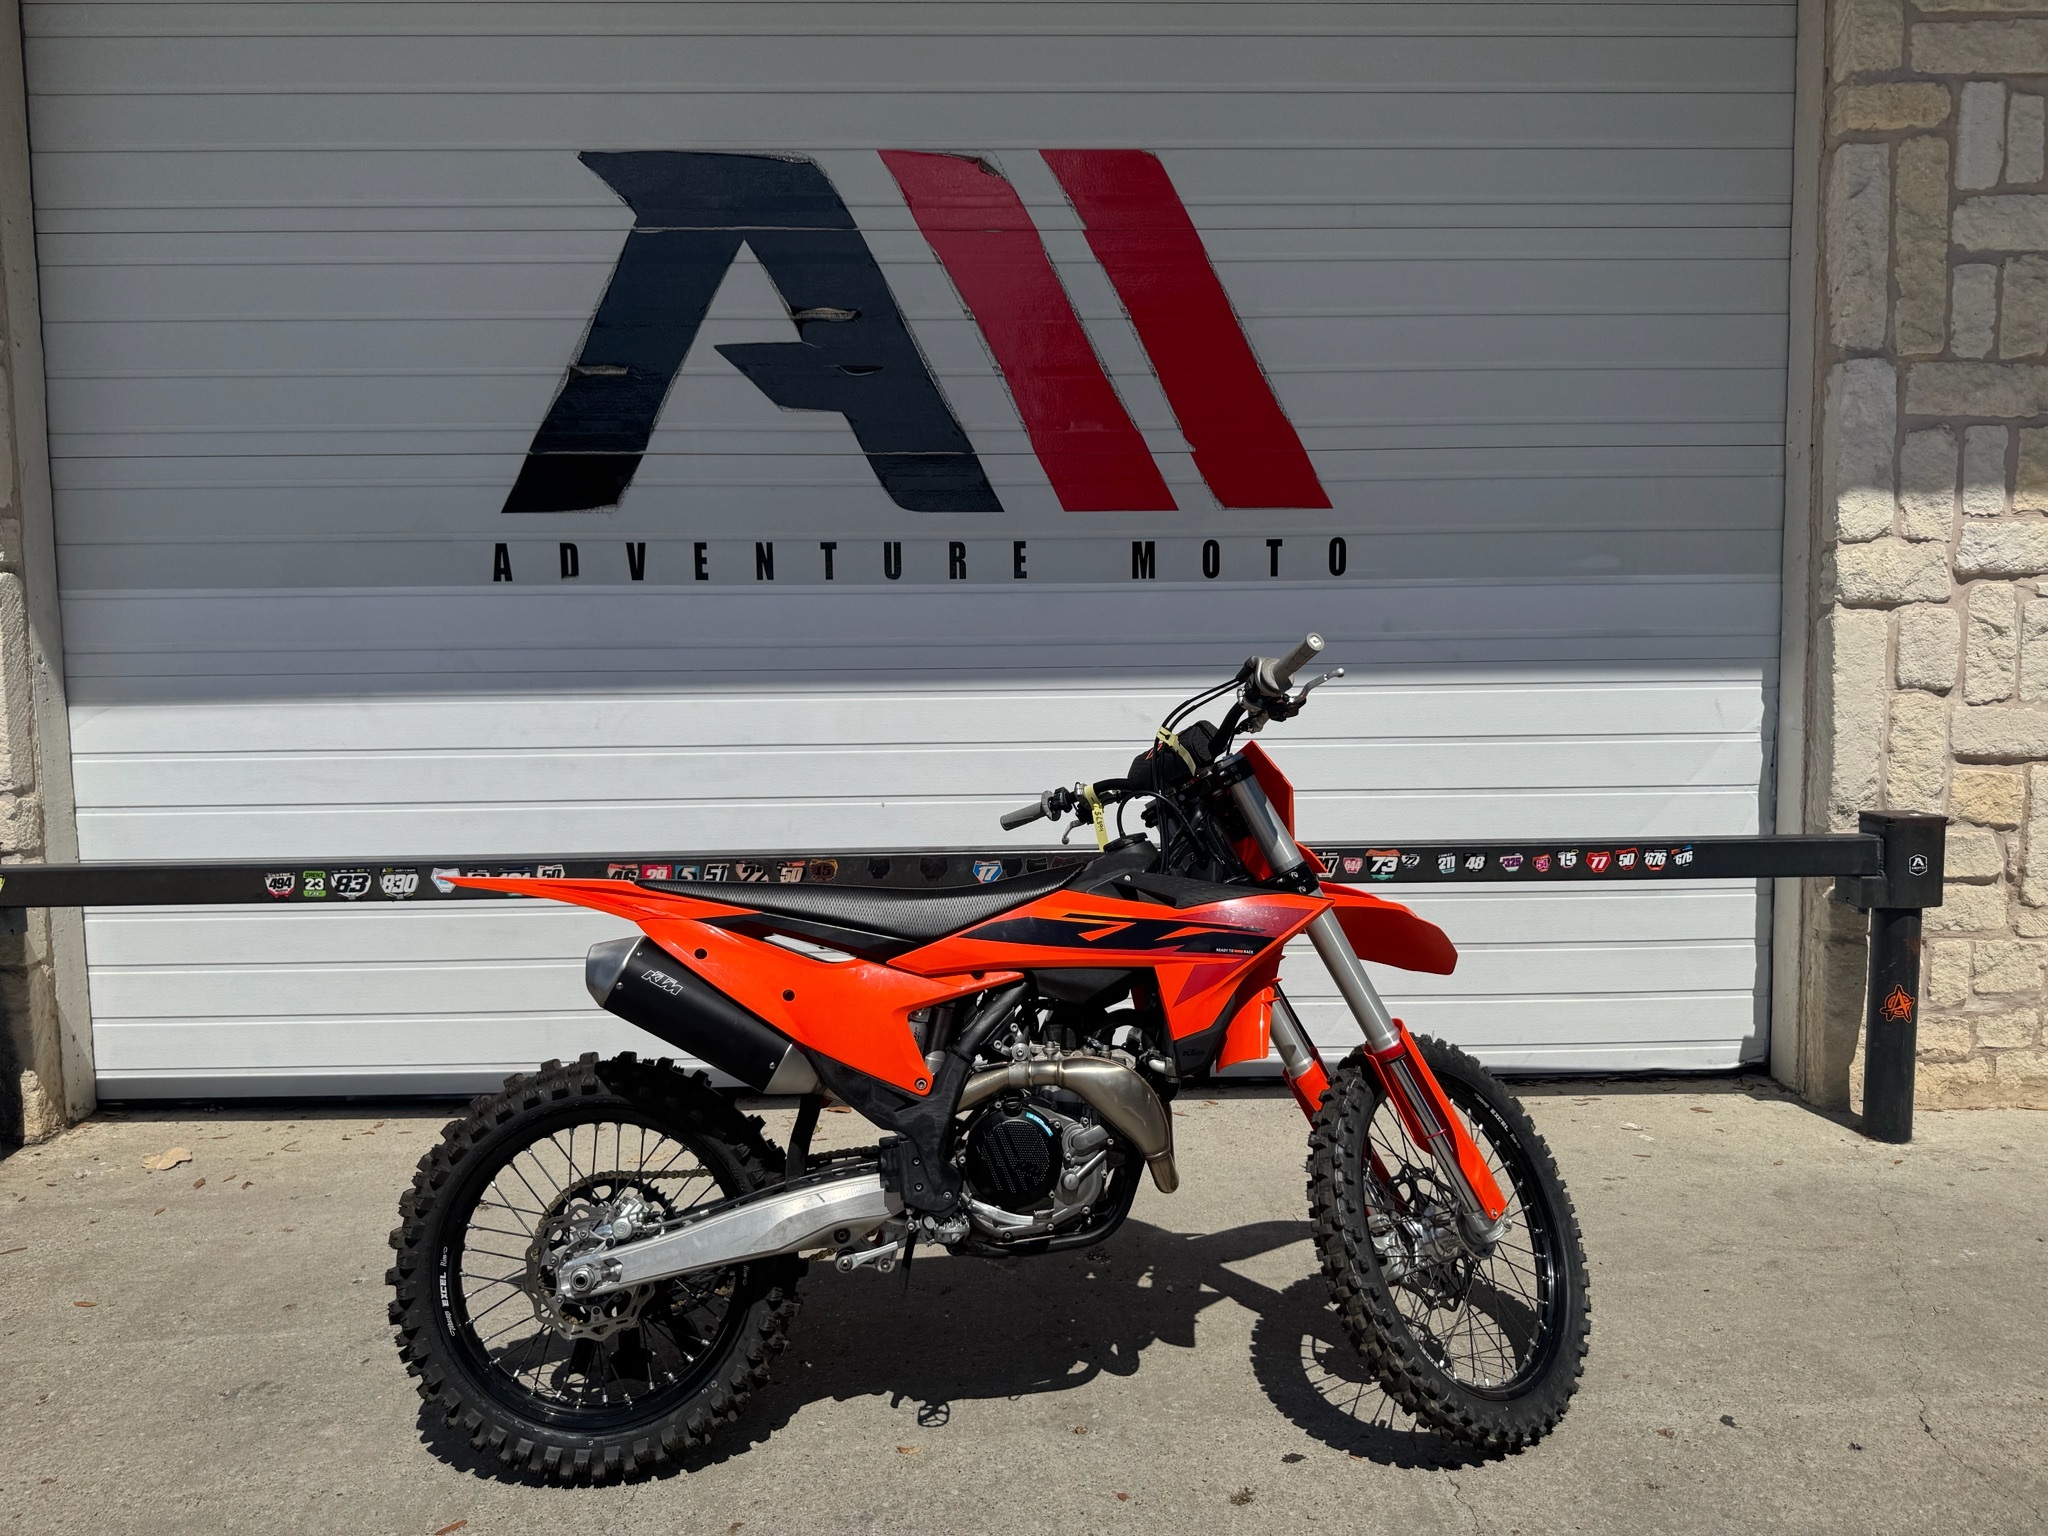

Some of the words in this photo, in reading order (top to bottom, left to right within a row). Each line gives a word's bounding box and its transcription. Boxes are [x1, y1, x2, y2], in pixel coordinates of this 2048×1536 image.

[493, 541, 1027, 582] ADVENTURE
[1131, 537, 1347, 580] MOTO
[1370, 857, 1398, 872] 73
[1438, 856, 1456, 870] 211
[1465, 856, 1485, 869] 48
[1591, 857, 1607, 869] 77
[979, 866, 998, 881] 17
[269, 878, 292, 889] 494
[305, 878, 324, 890] 23
[335, 875, 369, 893] 83
[383, 874, 419, 893] 830
[641, 969, 684, 996] KTM
[440, 1272, 449, 1307] EXCEL
